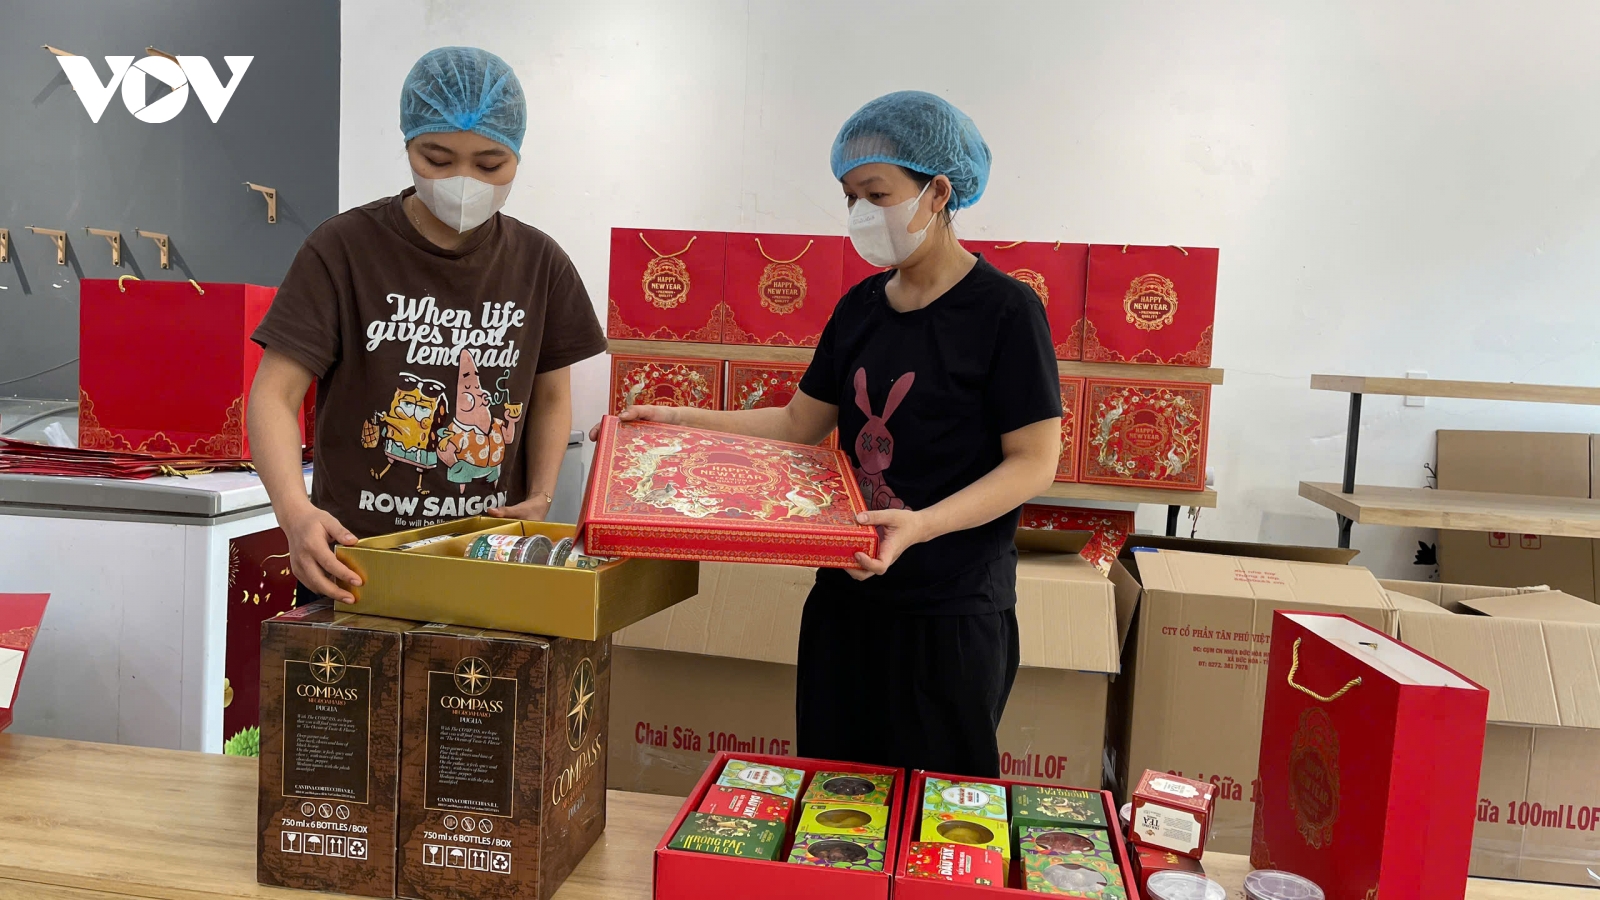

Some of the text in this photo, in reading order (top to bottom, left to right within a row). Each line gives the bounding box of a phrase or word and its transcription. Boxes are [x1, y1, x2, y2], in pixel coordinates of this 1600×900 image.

[773, 281, 793, 289] HAPPY
[781, 288, 798, 296] YEAR
[1133, 302, 1168, 311] NEW YEAR
[386, 293, 525, 338] When life
[366, 320, 505, 352] gives you
[712, 466, 750, 474] HAPPY
[731, 472, 763, 480] YEAR
[358, 490, 419, 517] ROW
[395, 517, 407, 526] life
[408, 518, 422, 527] will
[1161, 624, 1271, 645] CTY CỔ PHẦN TÂN PHÚ VIỆT
[296, 684, 358, 701] COMPASS
[315, 704, 338, 712] PUGLIA
[440, 695, 504, 713] COMPASS
[459, 716, 482, 725] PUGLIA
[635, 721, 668, 747] Chai
[672, 726, 701, 752] Sữa
[552, 733, 602, 806] COMPASS
[999, 751, 1068, 779] 0ml LOF
[1209, 774, 1242, 801] Sữa
[1143, 816, 1160, 828] TEA
[1476, 798, 1600, 831] ữa 100ml LOF
[281, 818, 295, 827] 750
[316, 821, 348, 832] BOTTLES
[352, 825, 368, 834] BOX
[423, 831, 437, 839] 750
[438, 832, 448, 840] ml
[459, 834, 491, 845] BOTTLES
[495, 838, 512, 848] BOX
